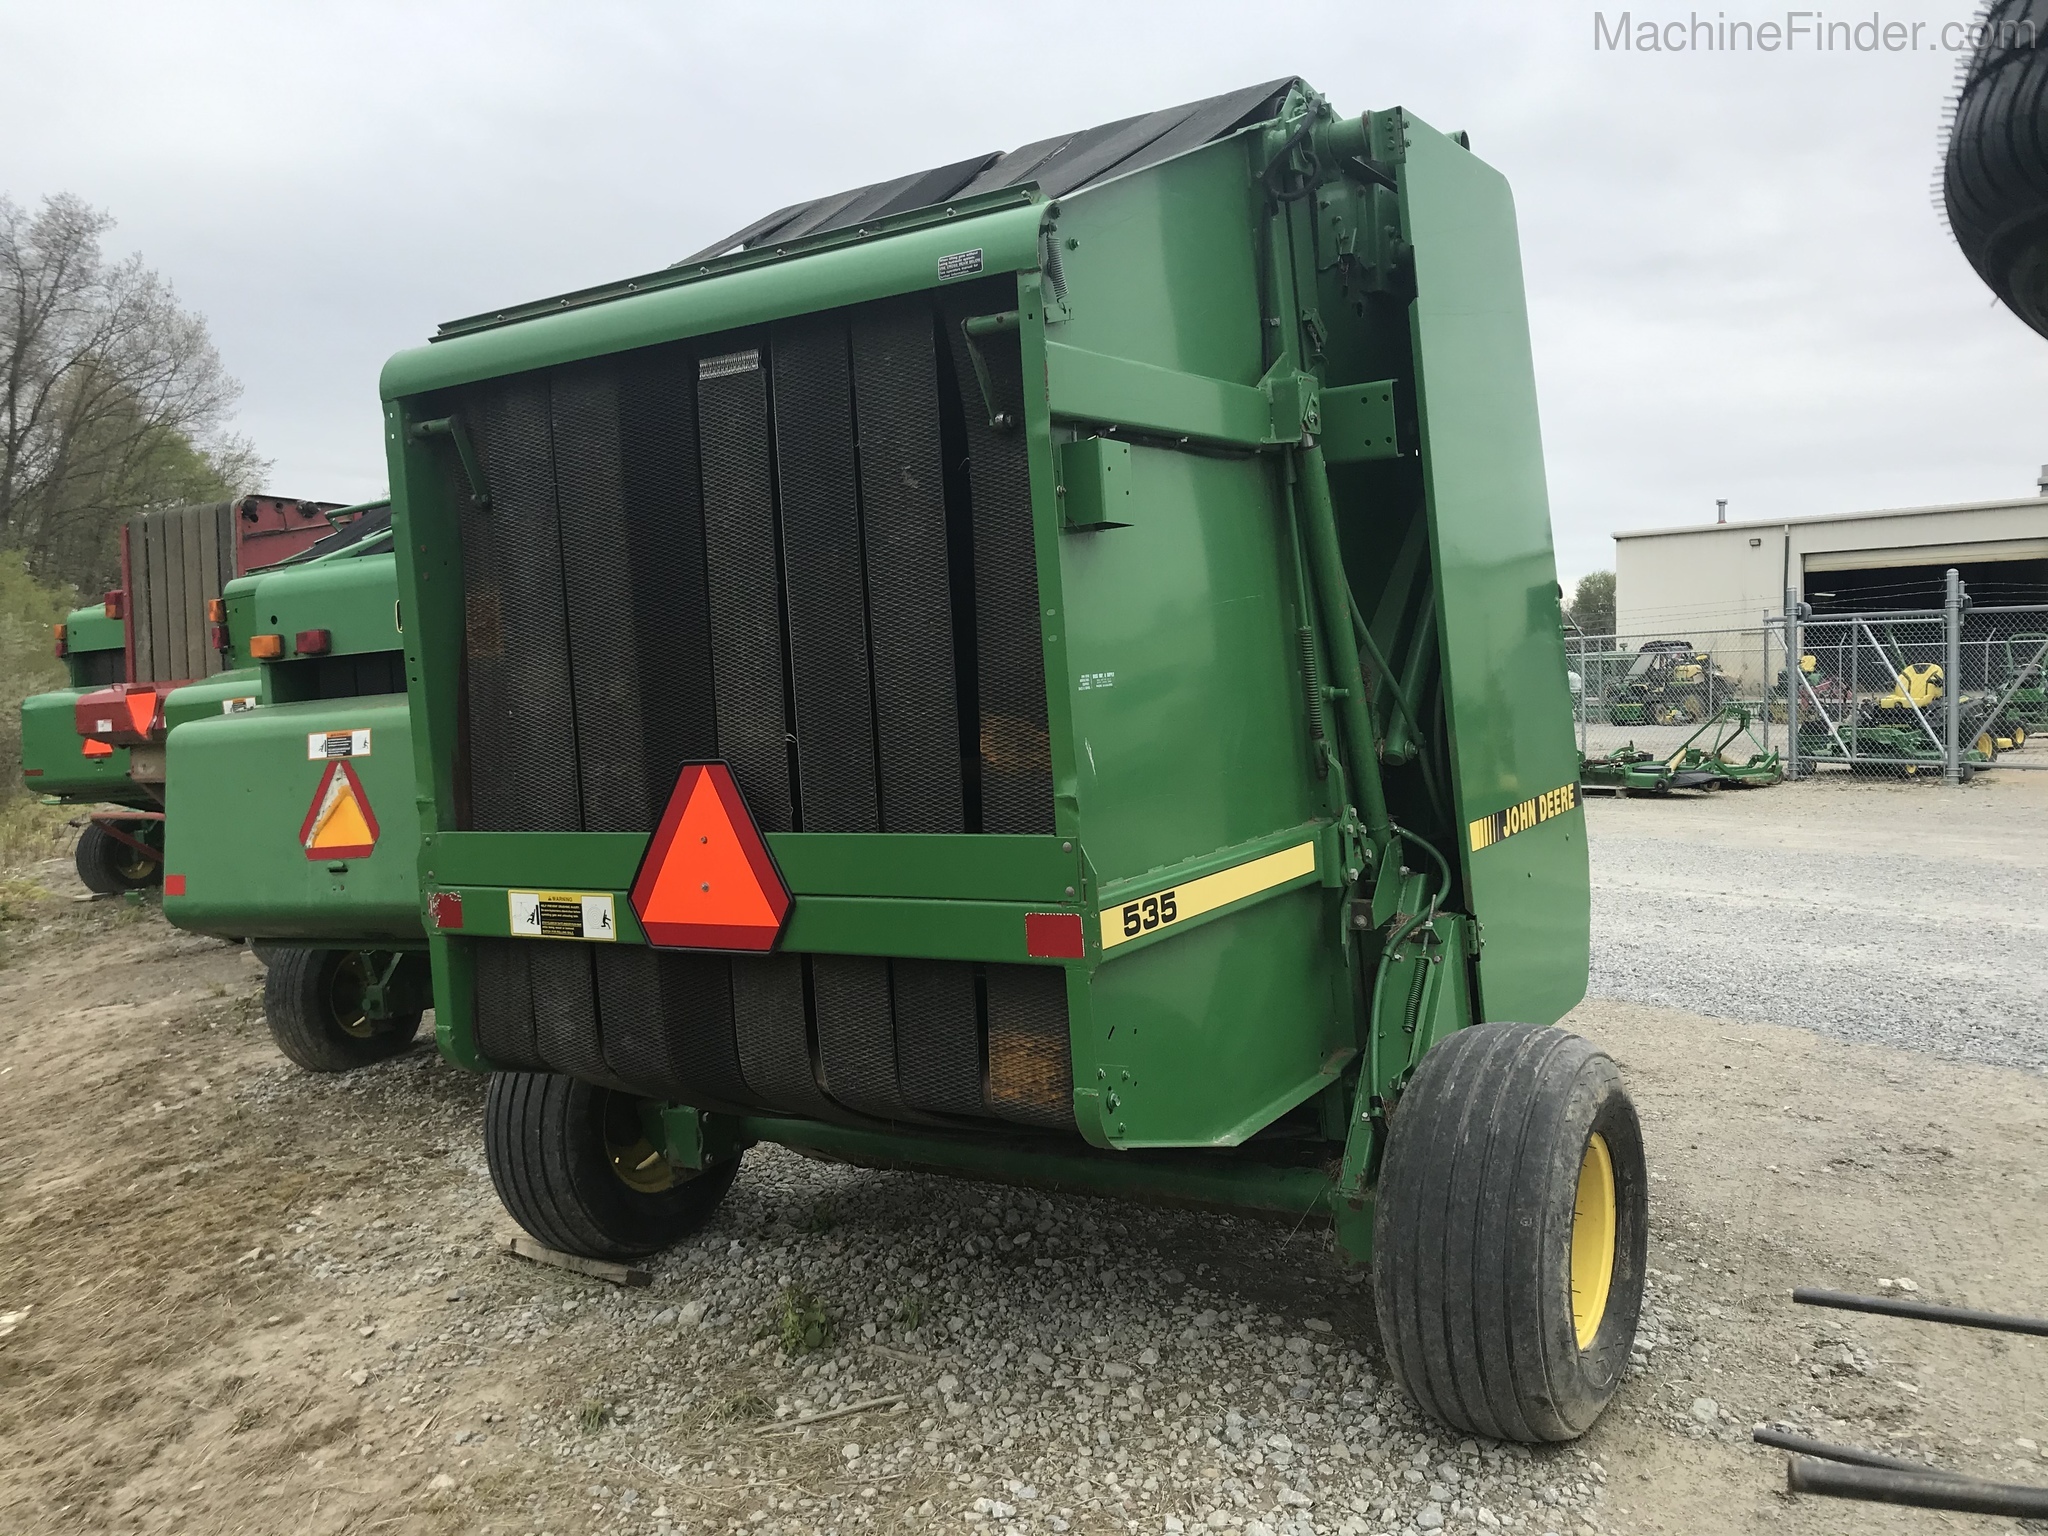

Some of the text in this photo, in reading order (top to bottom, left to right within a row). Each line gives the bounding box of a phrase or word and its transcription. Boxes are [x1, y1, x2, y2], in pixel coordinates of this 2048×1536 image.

[1503, 783, 1576, 838] JOHN DEERE
[1122, 890, 1178, 938] 535
